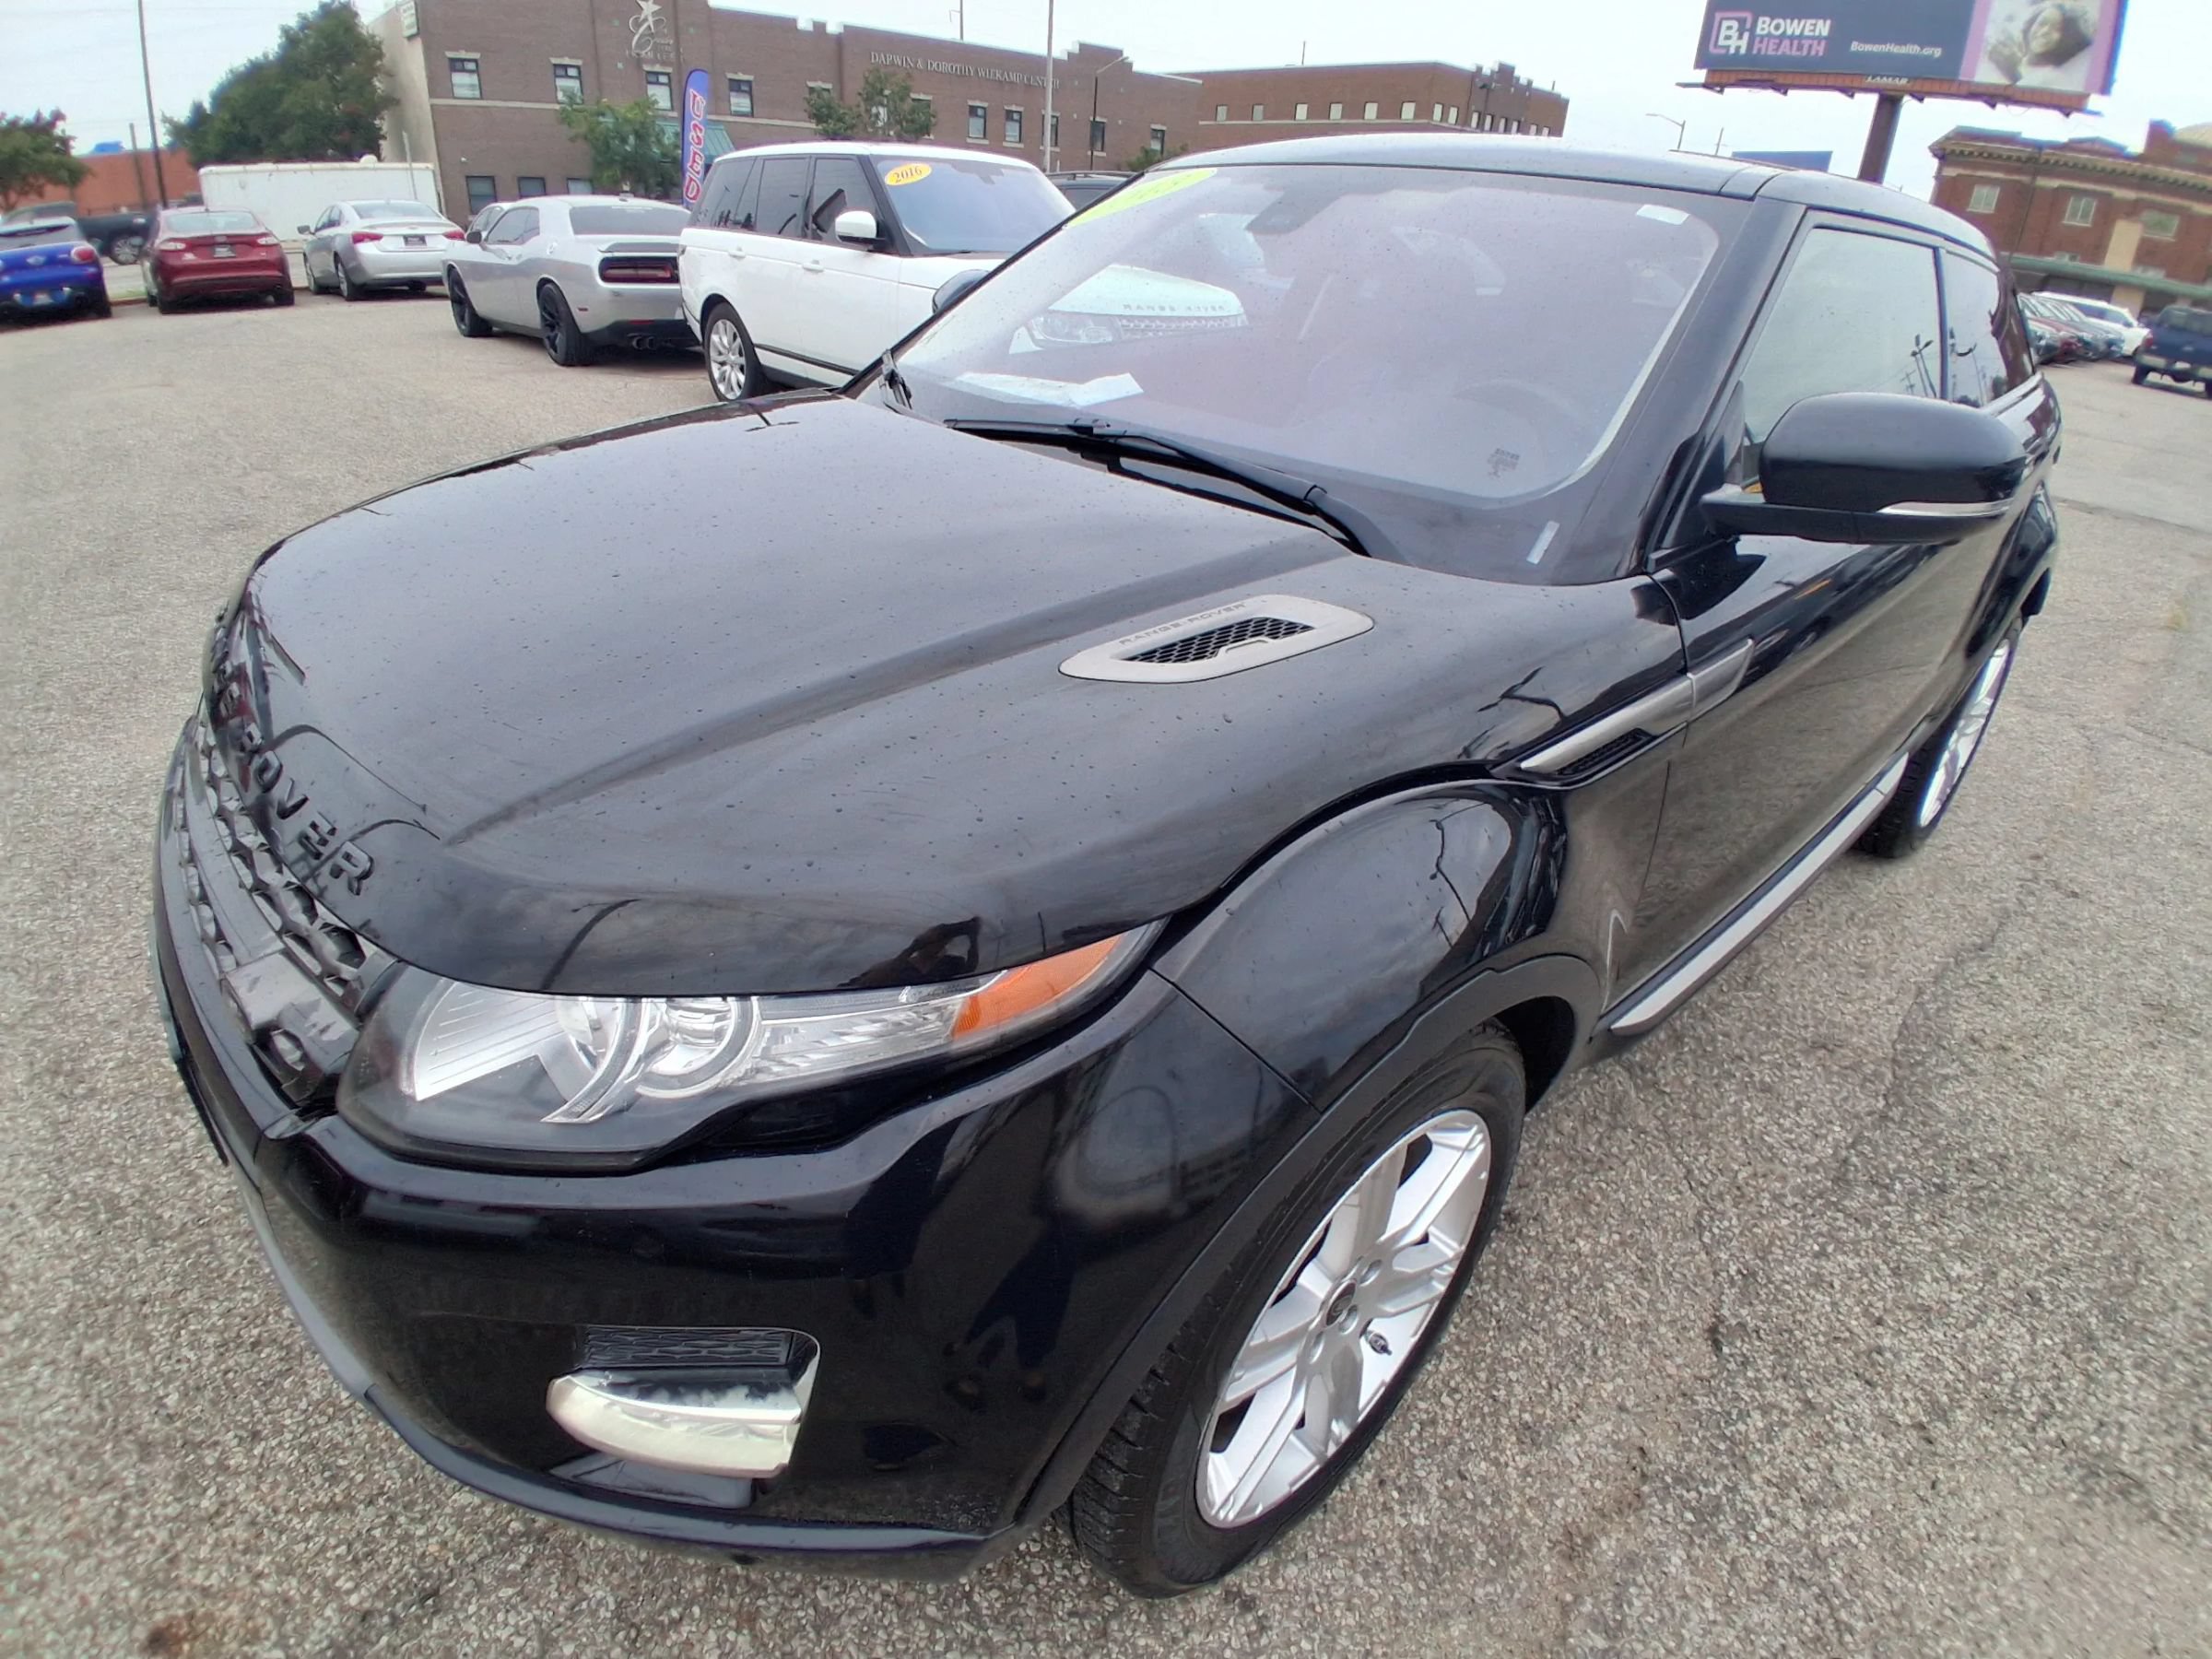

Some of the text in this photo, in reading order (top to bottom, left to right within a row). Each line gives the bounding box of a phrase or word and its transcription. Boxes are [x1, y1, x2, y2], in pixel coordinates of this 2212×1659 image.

[1756, 17, 1831, 37] BOWEN
[1752, 37, 1828, 56] HEALTH
[1850, 41, 1942, 57] BowenHealth.org
[927, 59, 974, 76] DOROTHY
[1023, 73, 1060, 89] CENTR
[684, 88, 706, 203] USED
[893, 166, 923, 183] 2016
[1119, 621, 1183, 645] RANGE
